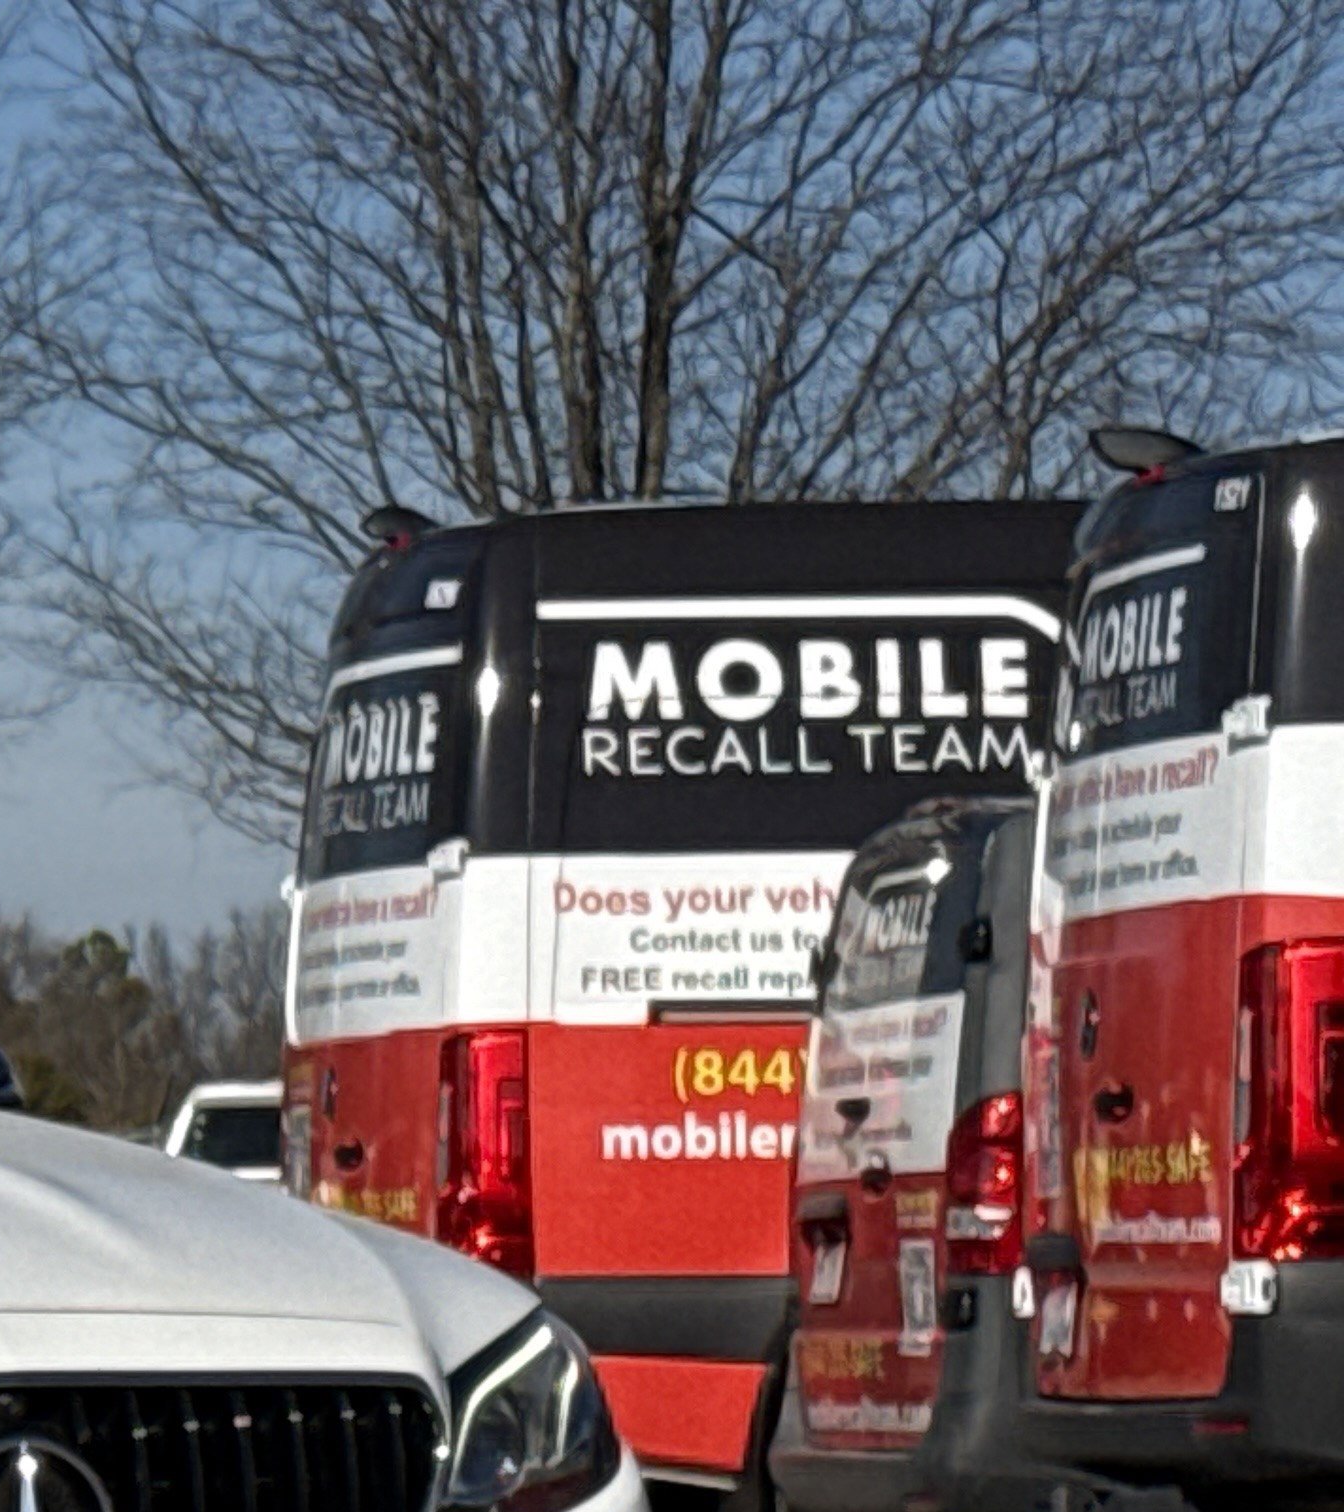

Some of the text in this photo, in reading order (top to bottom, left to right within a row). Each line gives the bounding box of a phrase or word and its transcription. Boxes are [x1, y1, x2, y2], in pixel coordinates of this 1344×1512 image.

[1081, 585, 1187, 682] MOBILE
[588, 637, 1028, 721] MOBILE
[1127, 671, 1177, 718] TEAM
[324, 691, 440, 788] MOBILE
[583, 726, 1032, 776] RECALL TEAM
[373, 781, 429, 829] TEAM
[554, 881, 651, 916] Does
[665, 885, 754, 921] your
[629, 928, 741, 953] Contact
[750, 932, 783, 953] us
[581, 966, 813, 997] FREE recall rep
